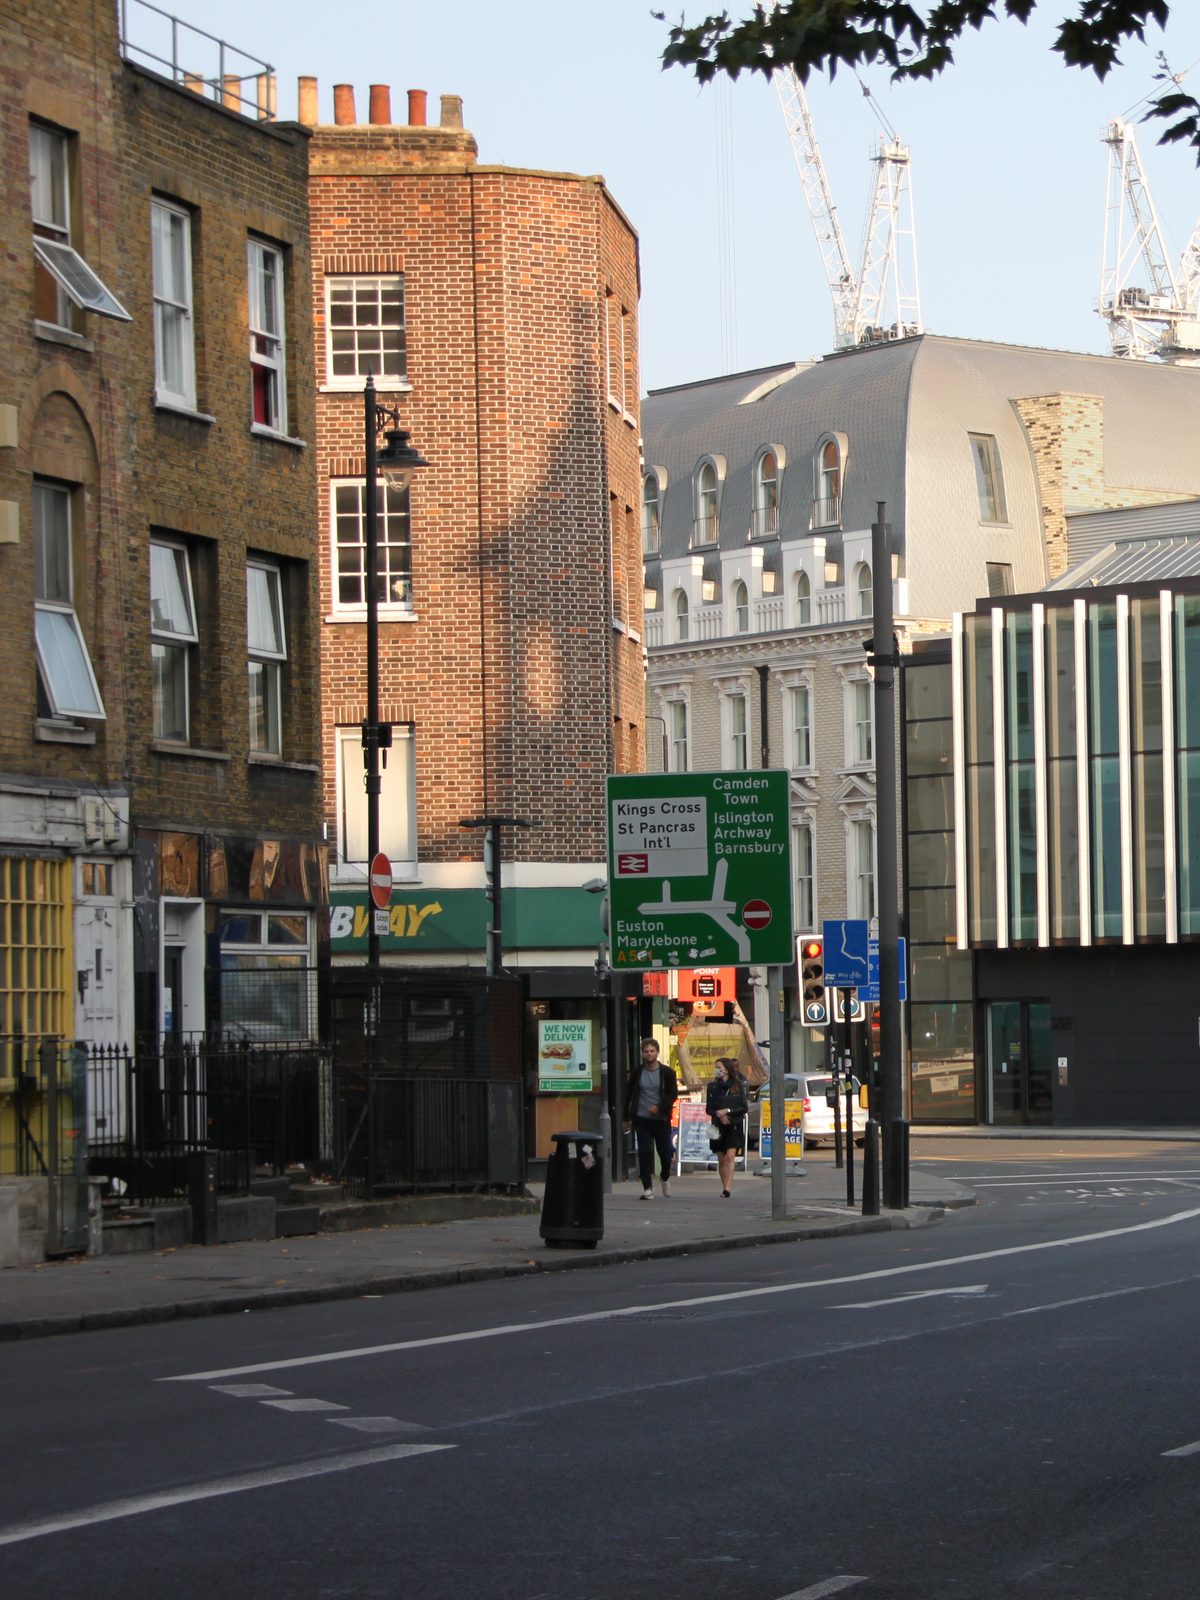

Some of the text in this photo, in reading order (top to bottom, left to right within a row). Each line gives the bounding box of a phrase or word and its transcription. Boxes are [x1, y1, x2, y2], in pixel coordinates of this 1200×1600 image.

[713, 778, 768, 790] Camden
[724, 792, 758, 805] Town
[618, 802, 701, 817] Kings Cross
[714, 812, 774, 826] Islington
[618, 822, 695, 834] St Pancras
[714, 828, 772, 840] Archway
[644, 836, 671, 848] Int'l
[716, 842, 784, 856] Barnsbury
[617, 920, 664, 932] Euston
[618, 935, 698, 949] Marylebone
[544, 1024, 586, 1033] WE NOW
